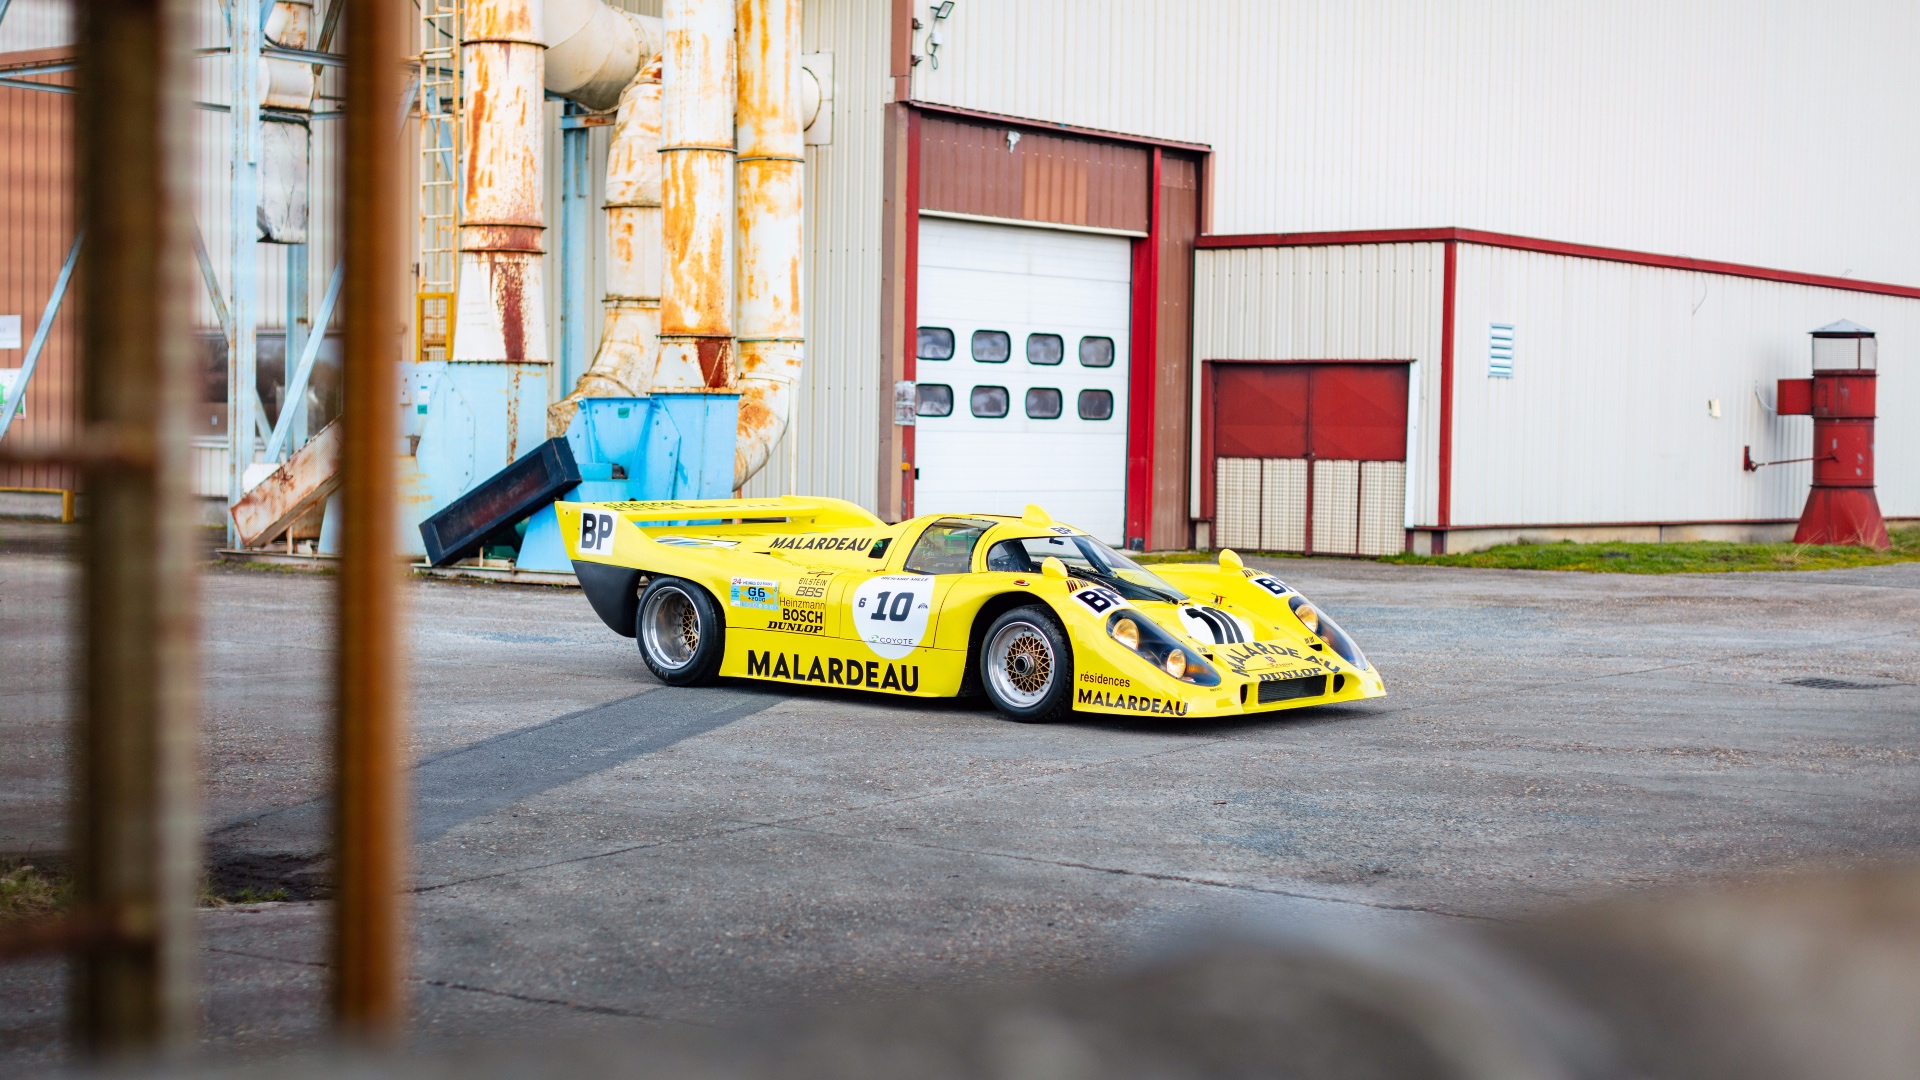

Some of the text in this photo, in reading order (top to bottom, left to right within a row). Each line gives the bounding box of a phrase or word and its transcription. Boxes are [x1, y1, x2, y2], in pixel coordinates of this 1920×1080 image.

[581, 513, 614, 550] BP
[768, 537, 872, 552] MALARDEAU
[798, 577, 828, 587] BILSTEIN
[748, 587, 766, 598] G6
[795, 586, 825, 598] BBS
[780, 597, 825, 610] Heinzmann
[858, 591, 915, 622] 6 10
[1075, 587, 1121, 614] BP
[782, 608, 823, 624] BOSCH
[767, 621, 823, 634] DUNLOP
[879, 637, 914, 645] COYOTE
[747, 649, 919, 693] MALARDEAU
[1258, 667, 1322, 682] DUNLOP
[1080, 671, 1131, 688] résidences
[1077, 688, 1189, 716] MALARDEAU
